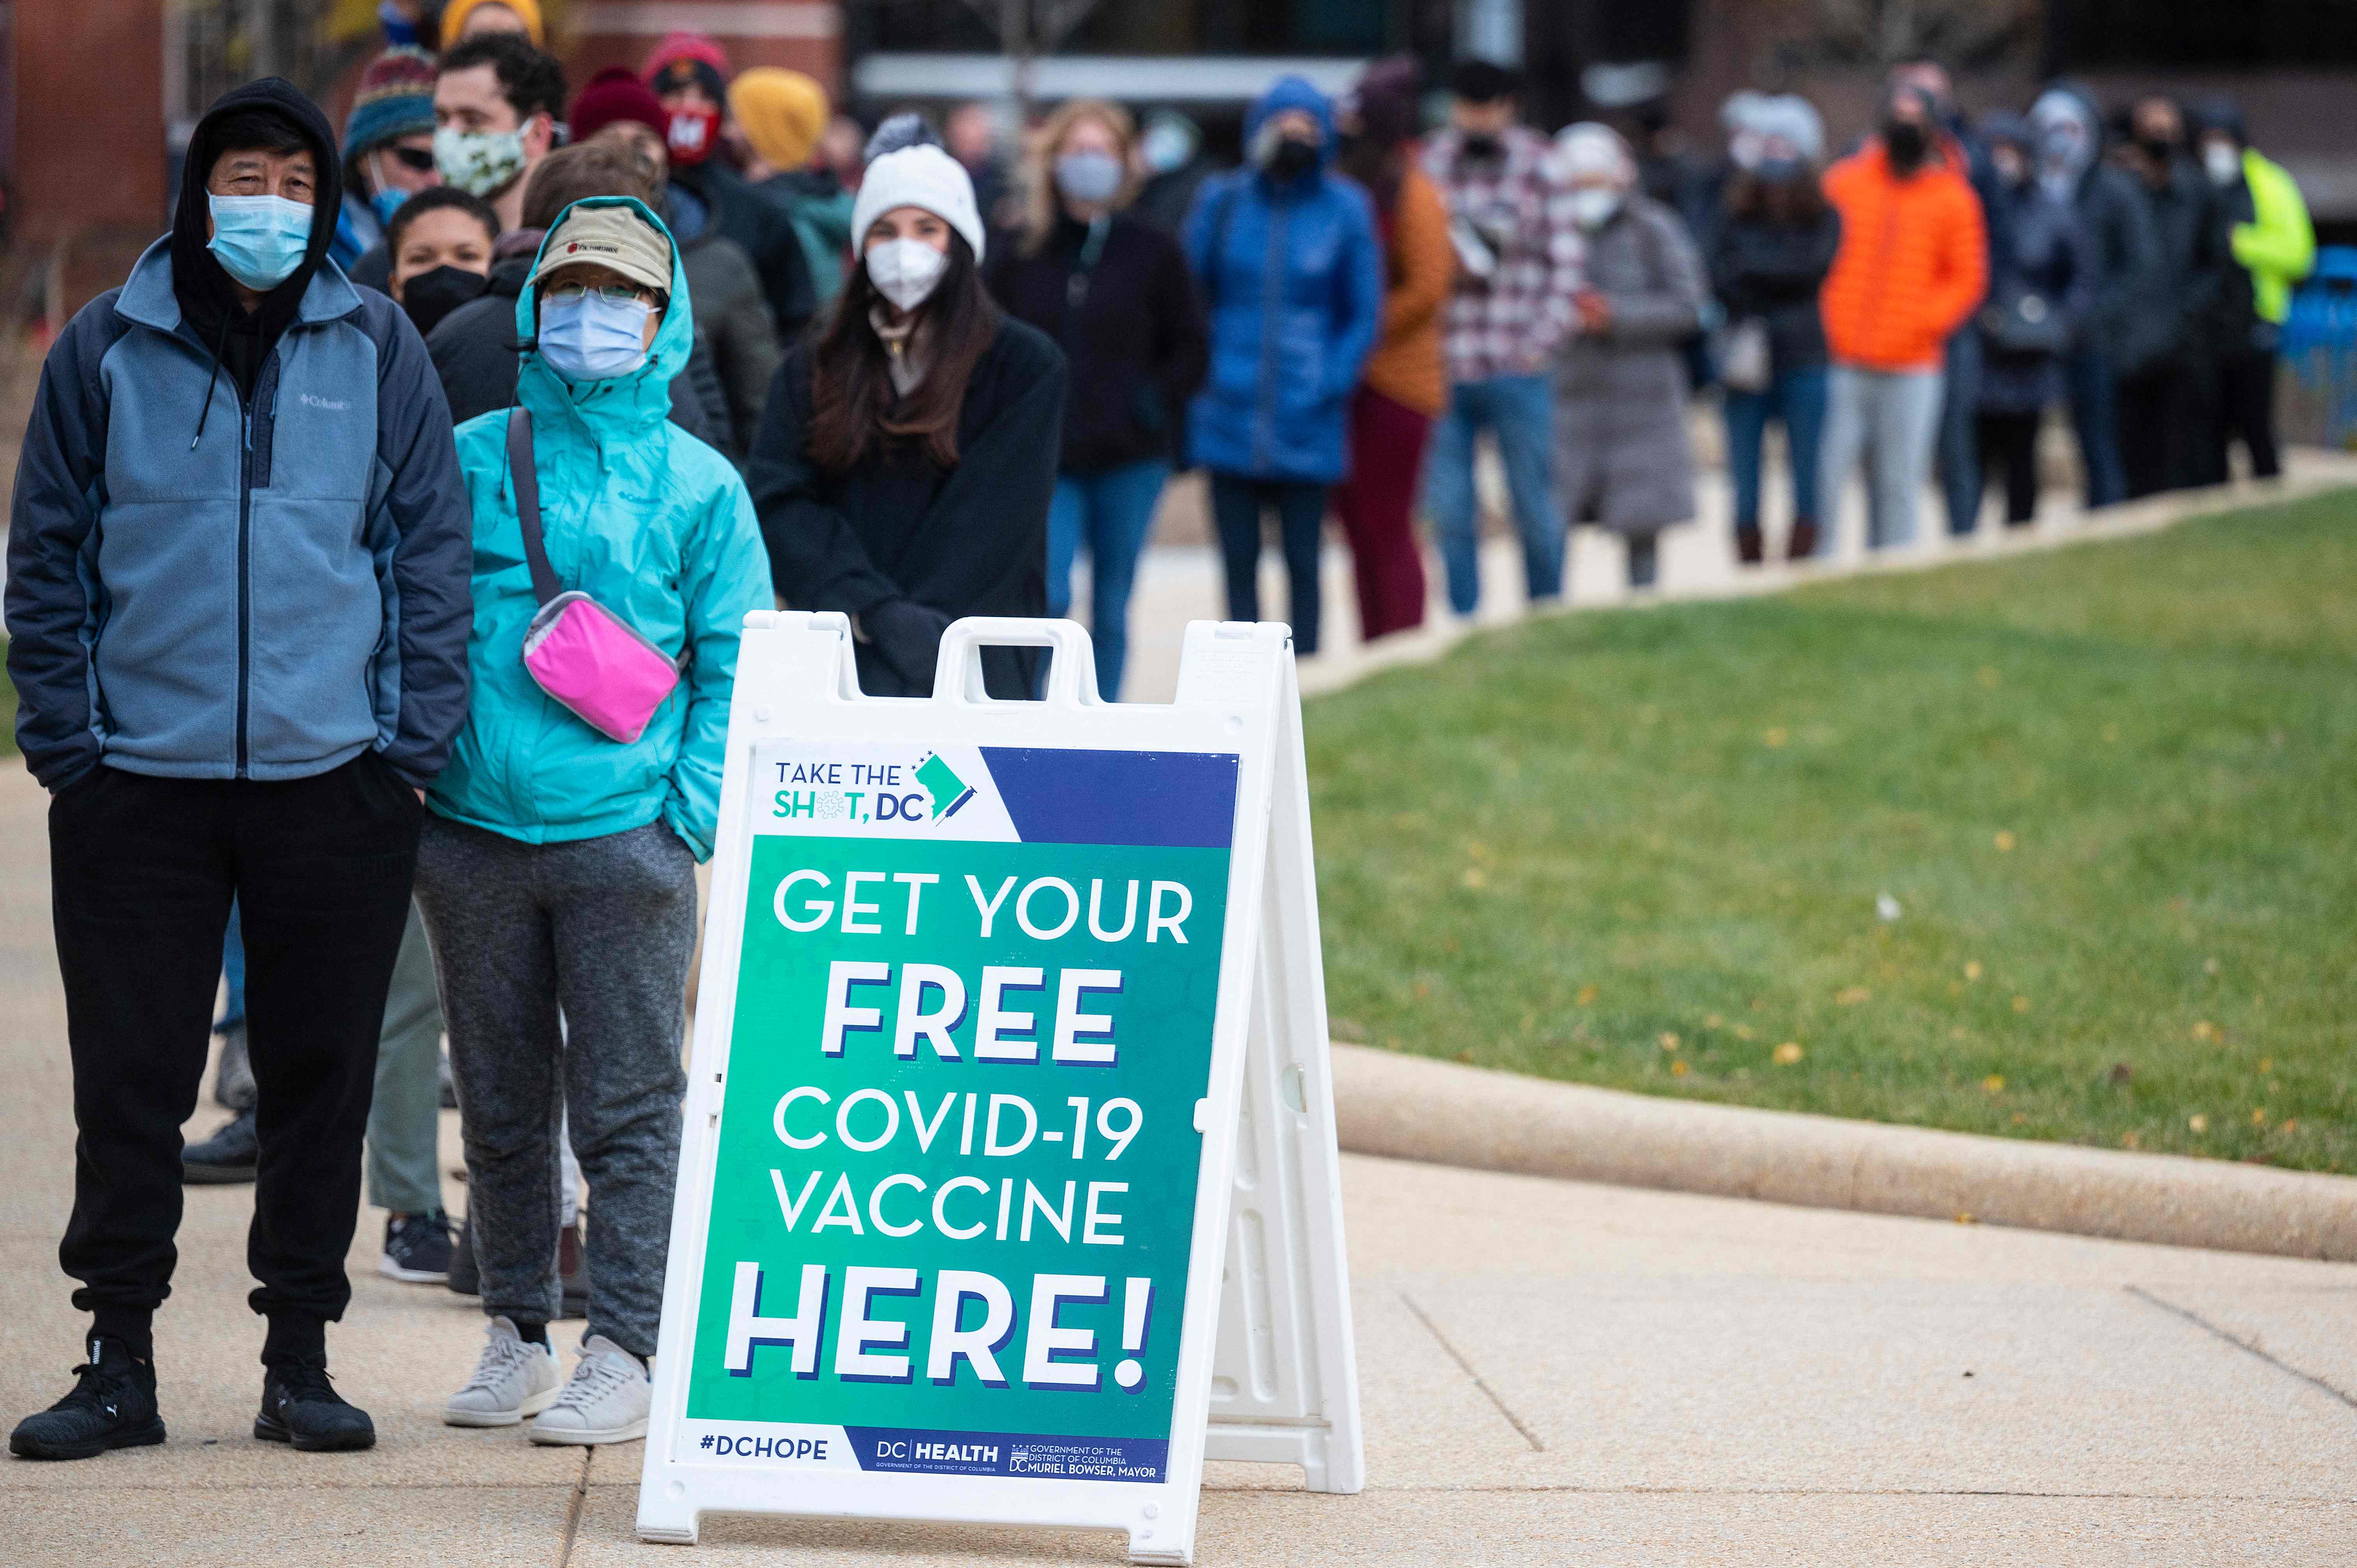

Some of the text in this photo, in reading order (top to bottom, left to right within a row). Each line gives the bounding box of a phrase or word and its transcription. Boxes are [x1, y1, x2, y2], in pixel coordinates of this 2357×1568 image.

[309, 395, 350, 410] Columb
[776, 762, 901, 786] TAKE THE
[876, 793, 924, 821] DC
[773, 869, 1193, 944] GET YOUR
[821, 961, 1124, 1067] FREE
[773, 1086, 1143, 1160] COVID-19
[770, 1169, 1129, 1245] VACCINE
[724, 1261, 1156, 1394] HERE!
[700, 1435, 829, 1460] #DCHOPE
[876, 1441, 998, 1462] DC HEALTH
[1029, 1454, 1066, 1462] DISTRICT
[1081, 1456, 1126, 1465] COLUMBIA
[1030, 1445, 1090, 1455] GOVERNMENT
[1028, 1463, 1066, 1474] MURIEL
[1069, 1465, 1116, 1476] BOWSER,
[1118, 1467, 1156, 1478] MAYOR
